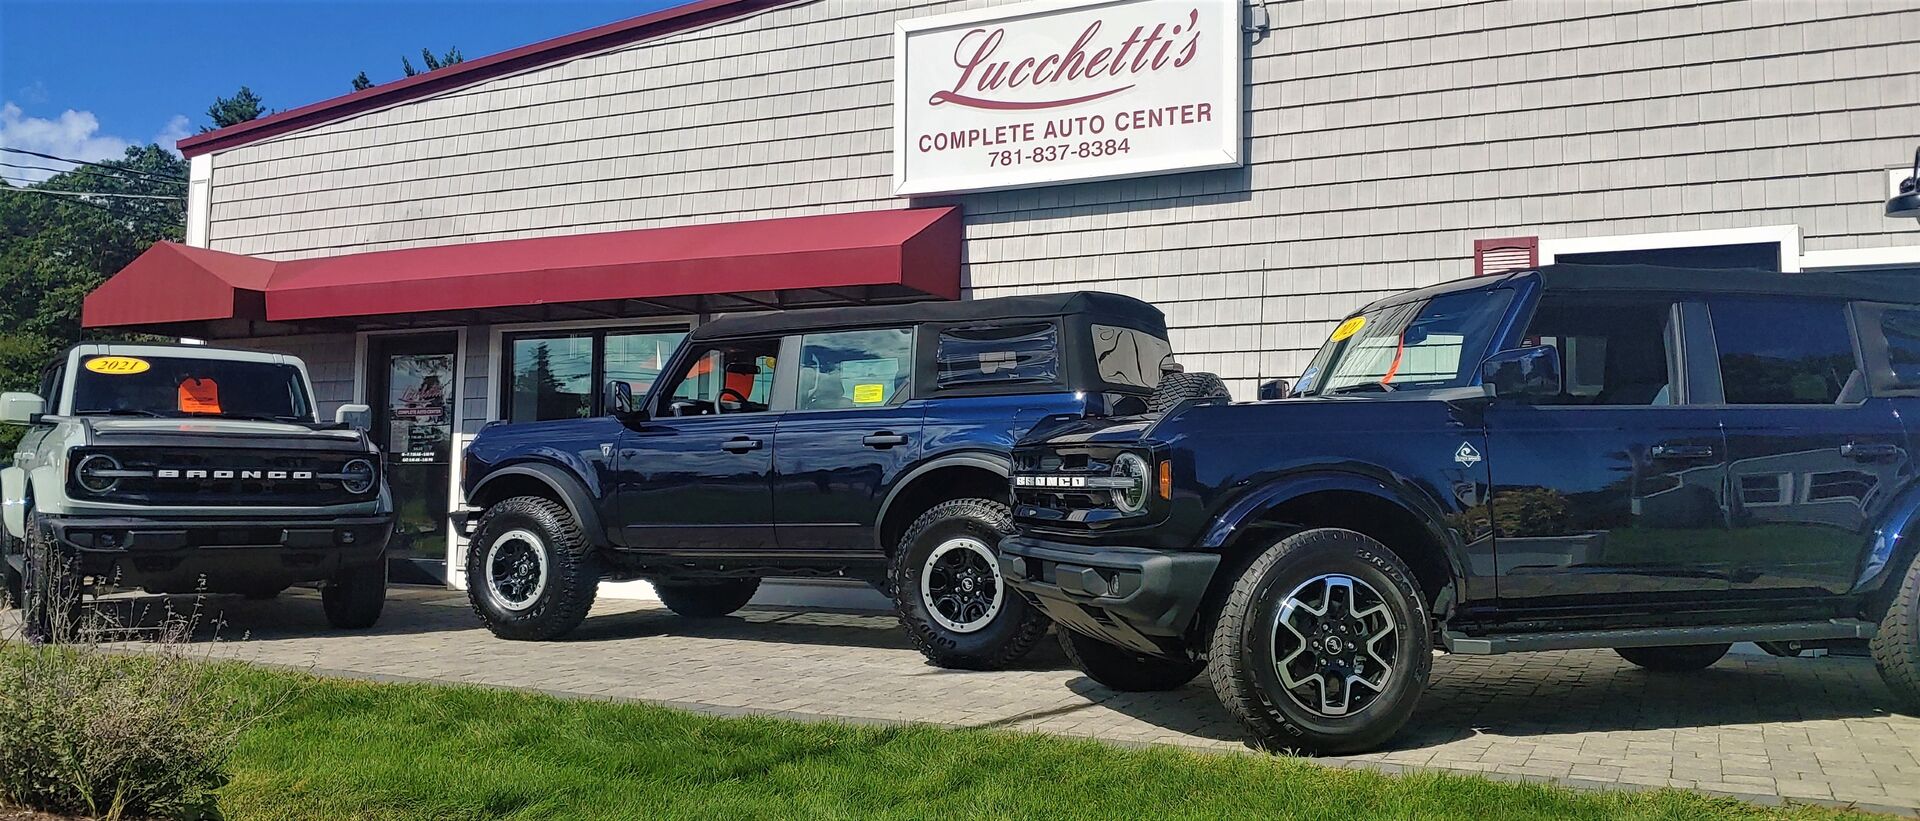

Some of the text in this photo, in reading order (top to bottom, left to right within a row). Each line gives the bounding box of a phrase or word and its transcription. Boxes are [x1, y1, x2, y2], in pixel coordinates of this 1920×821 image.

[929, 8, 1201, 110] Lucchetti's
[918, 102, 1213, 153] COMPLETE AUTO CENTER
[987, 137, 1131, 168] 781-837-8384
[96, 360, 140, 371] 2021
[158, 469, 312, 480] BRONCO
[1016, 476, 1085, 487] BRONCO
